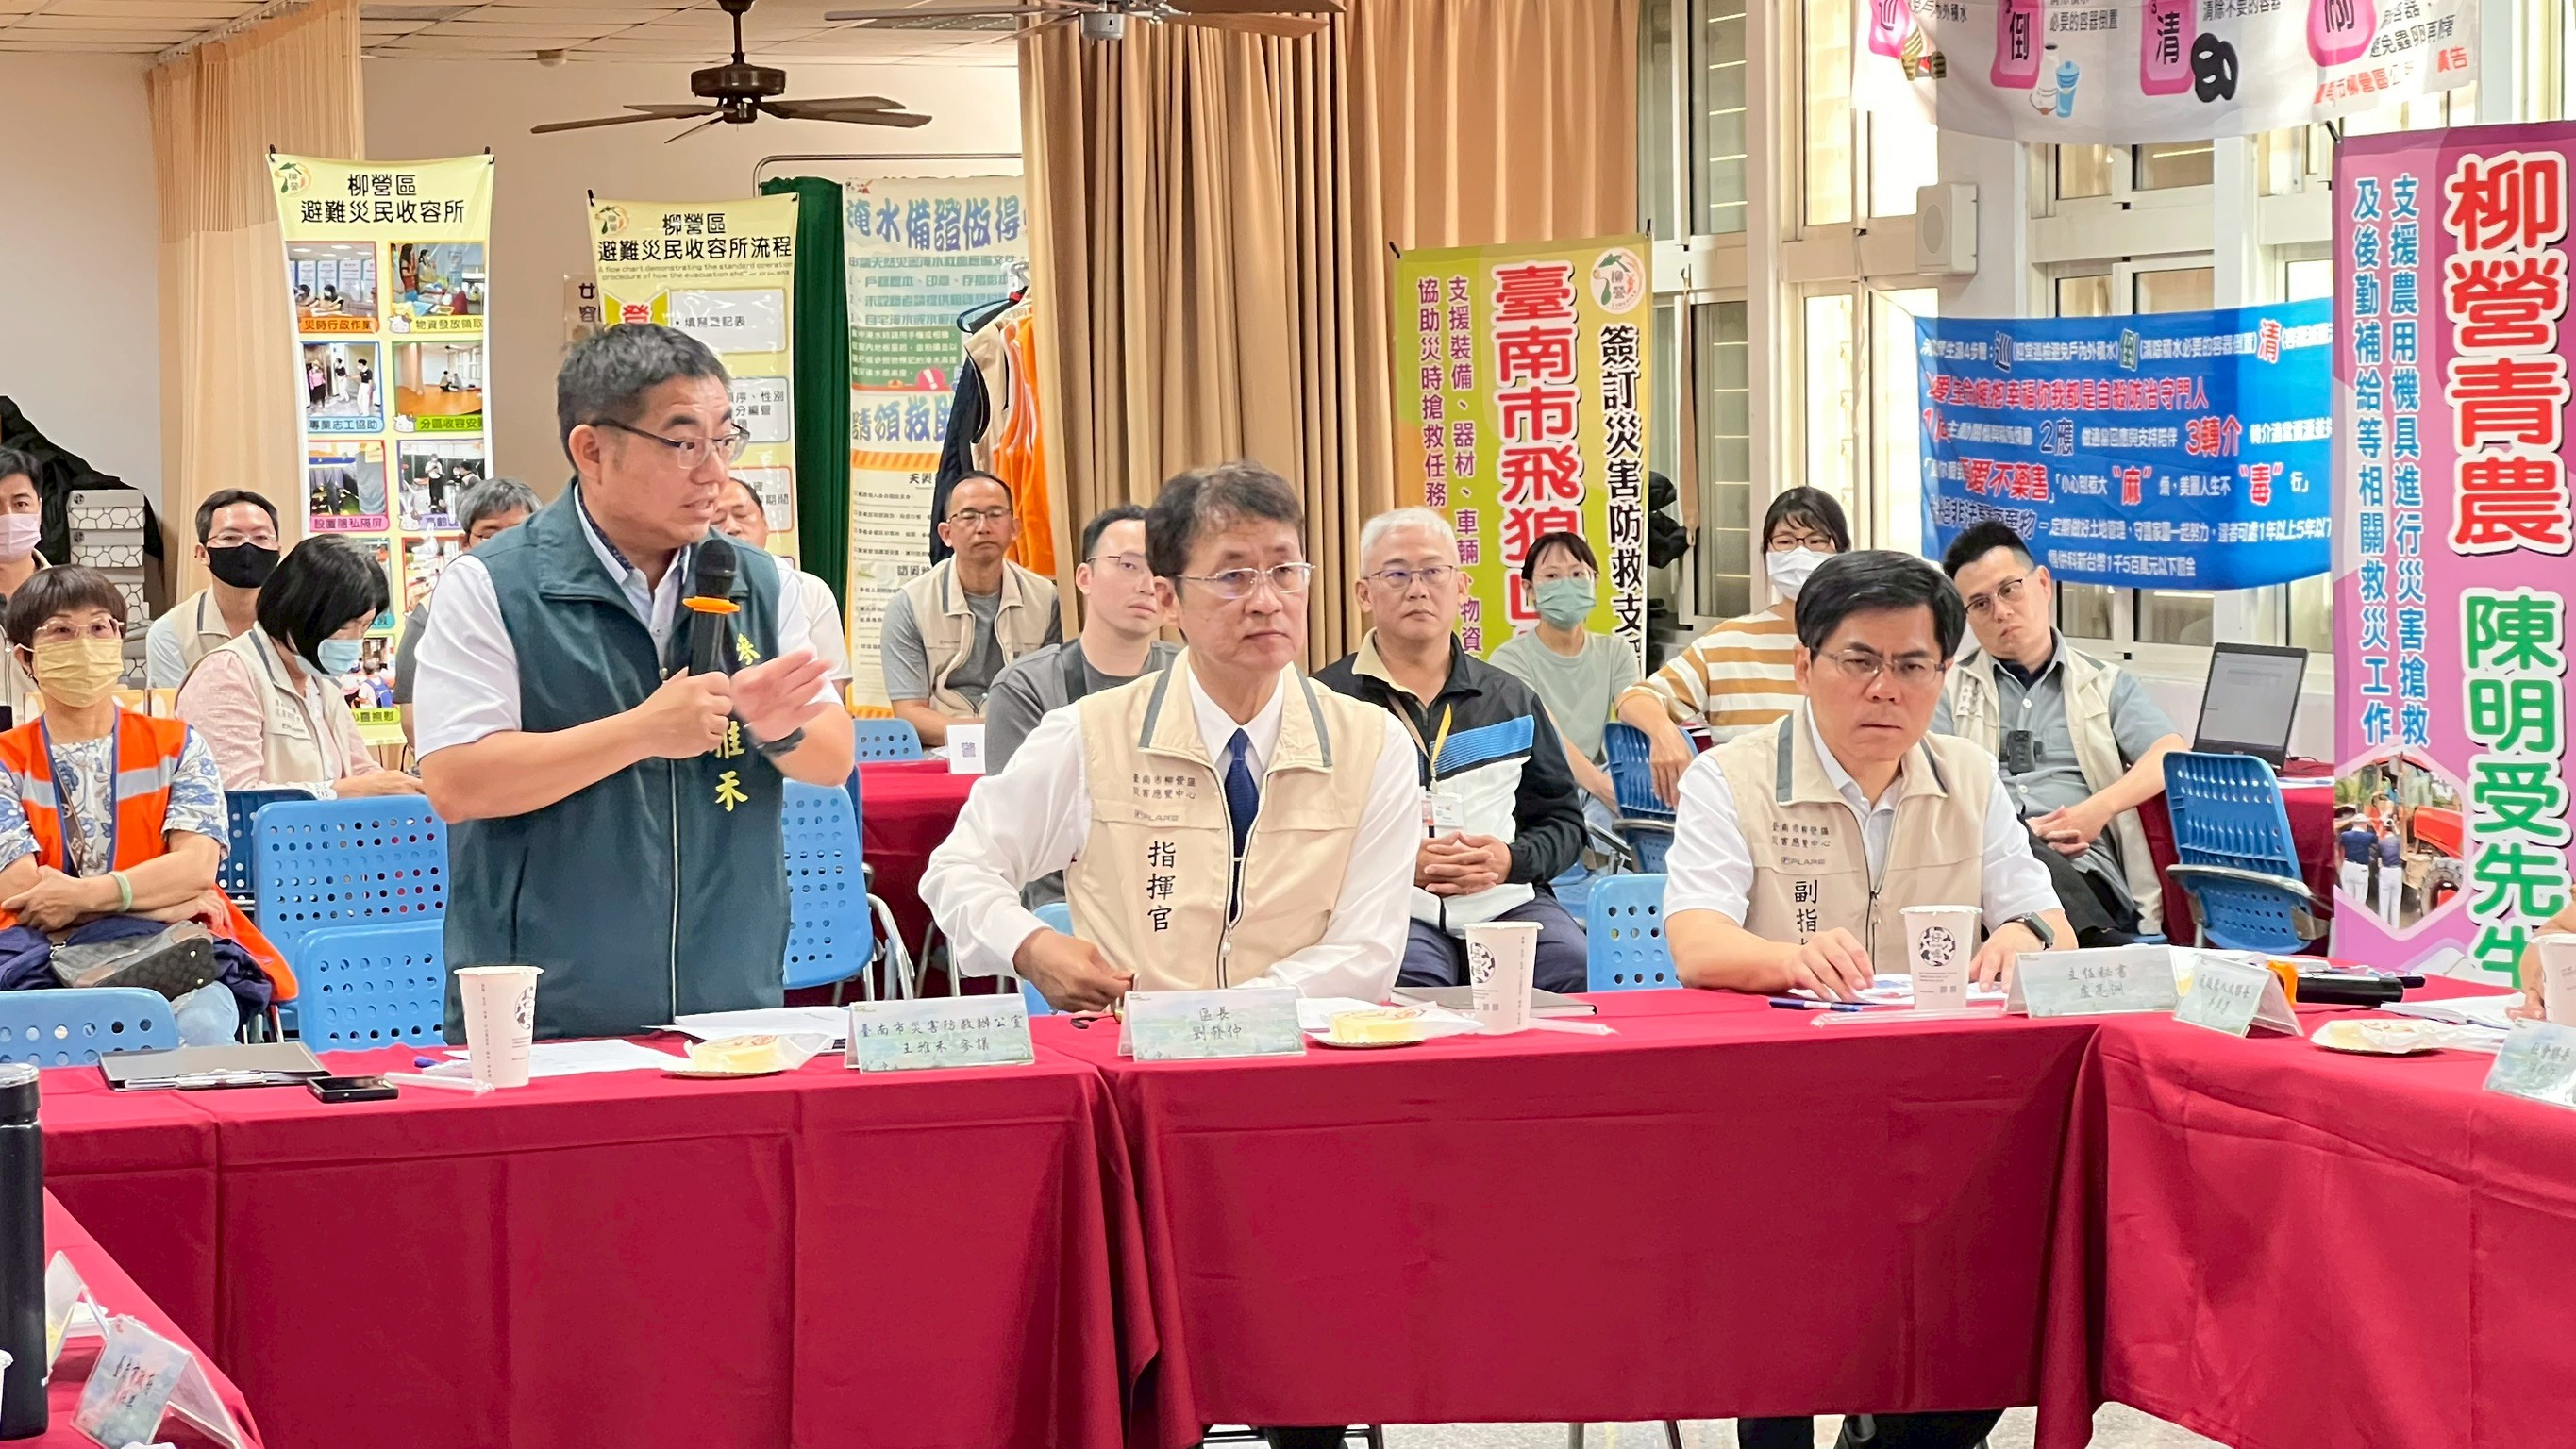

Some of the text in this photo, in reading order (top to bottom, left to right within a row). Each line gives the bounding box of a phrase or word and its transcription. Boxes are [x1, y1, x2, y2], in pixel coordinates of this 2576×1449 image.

[2011, 12, 2030, 60] 倒
[2049, 9, 2118, 31] 必要的容器倒置
[2156, 12, 2180, 65] 清
[347, 173, 417, 197] 柳營區
[301, 200, 465, 224] 避難災民收容所
[662, 213, 726, 236] 柳營區
[847, 194, 1026, 252] 淹水備證做得
[597, 236, 792, 262] 避難災民收容所流程
[304, 319, 373, 330] 災時行政作業
[1417, 278, 1447, 507] 協助災時搶救任務
[309, 419, 377, 430] 專業志工協助
[1495, 265, 1581, 620] 臺南市飛狼
[2185, 414, 2242, 458] 3轉介
[2353, 177, 2391, 744] 及後勤補給等相關救災工作
[2390, 175, 2429, 746] 支援農用機具進行災害搶救
[314, 517, 382, 529] 設置隱私隔屏
[2451, 158, 2565, 991] 柳營青農 陳明受先生
[1146, 841, 1177, 932] 指揮官
[1795, 879, 1818, 945] 副指
[860, 1015, 1023, 1038] 臺南市災害防救辦公室
[1199, 1006, 1230, 1022] 區長
